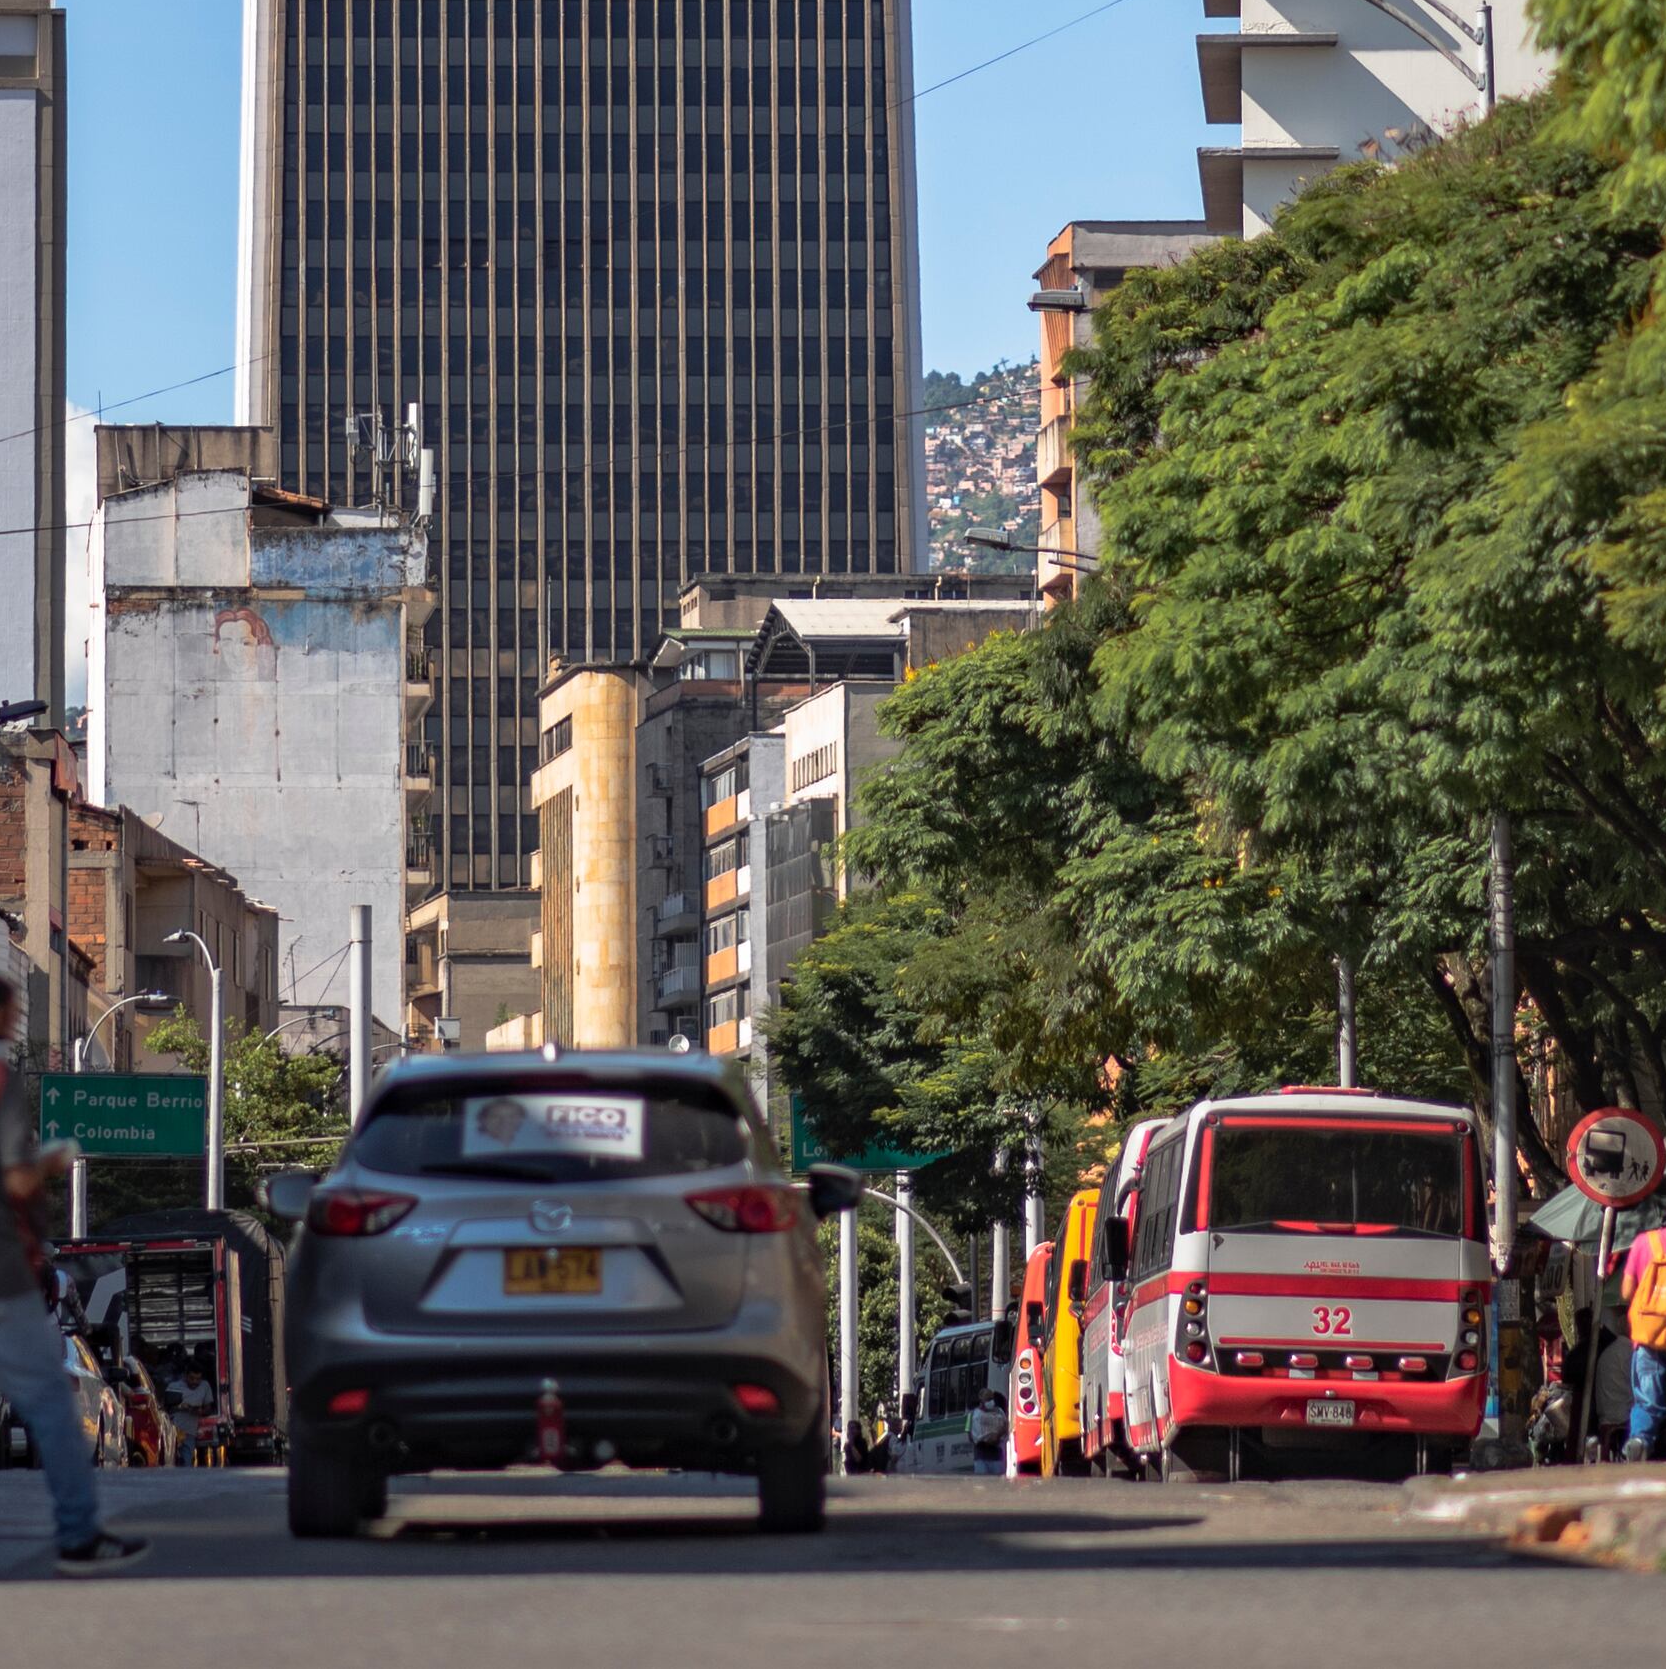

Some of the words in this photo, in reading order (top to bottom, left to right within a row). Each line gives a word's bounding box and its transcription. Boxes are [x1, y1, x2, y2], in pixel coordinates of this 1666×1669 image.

[73, 1090, 137, 1109] Parque
[146, 1092, 203, 1108] Berrio
[73, 1123, 156, 1140] Colombia
[1311, 1305, 1353, 1337] 32
